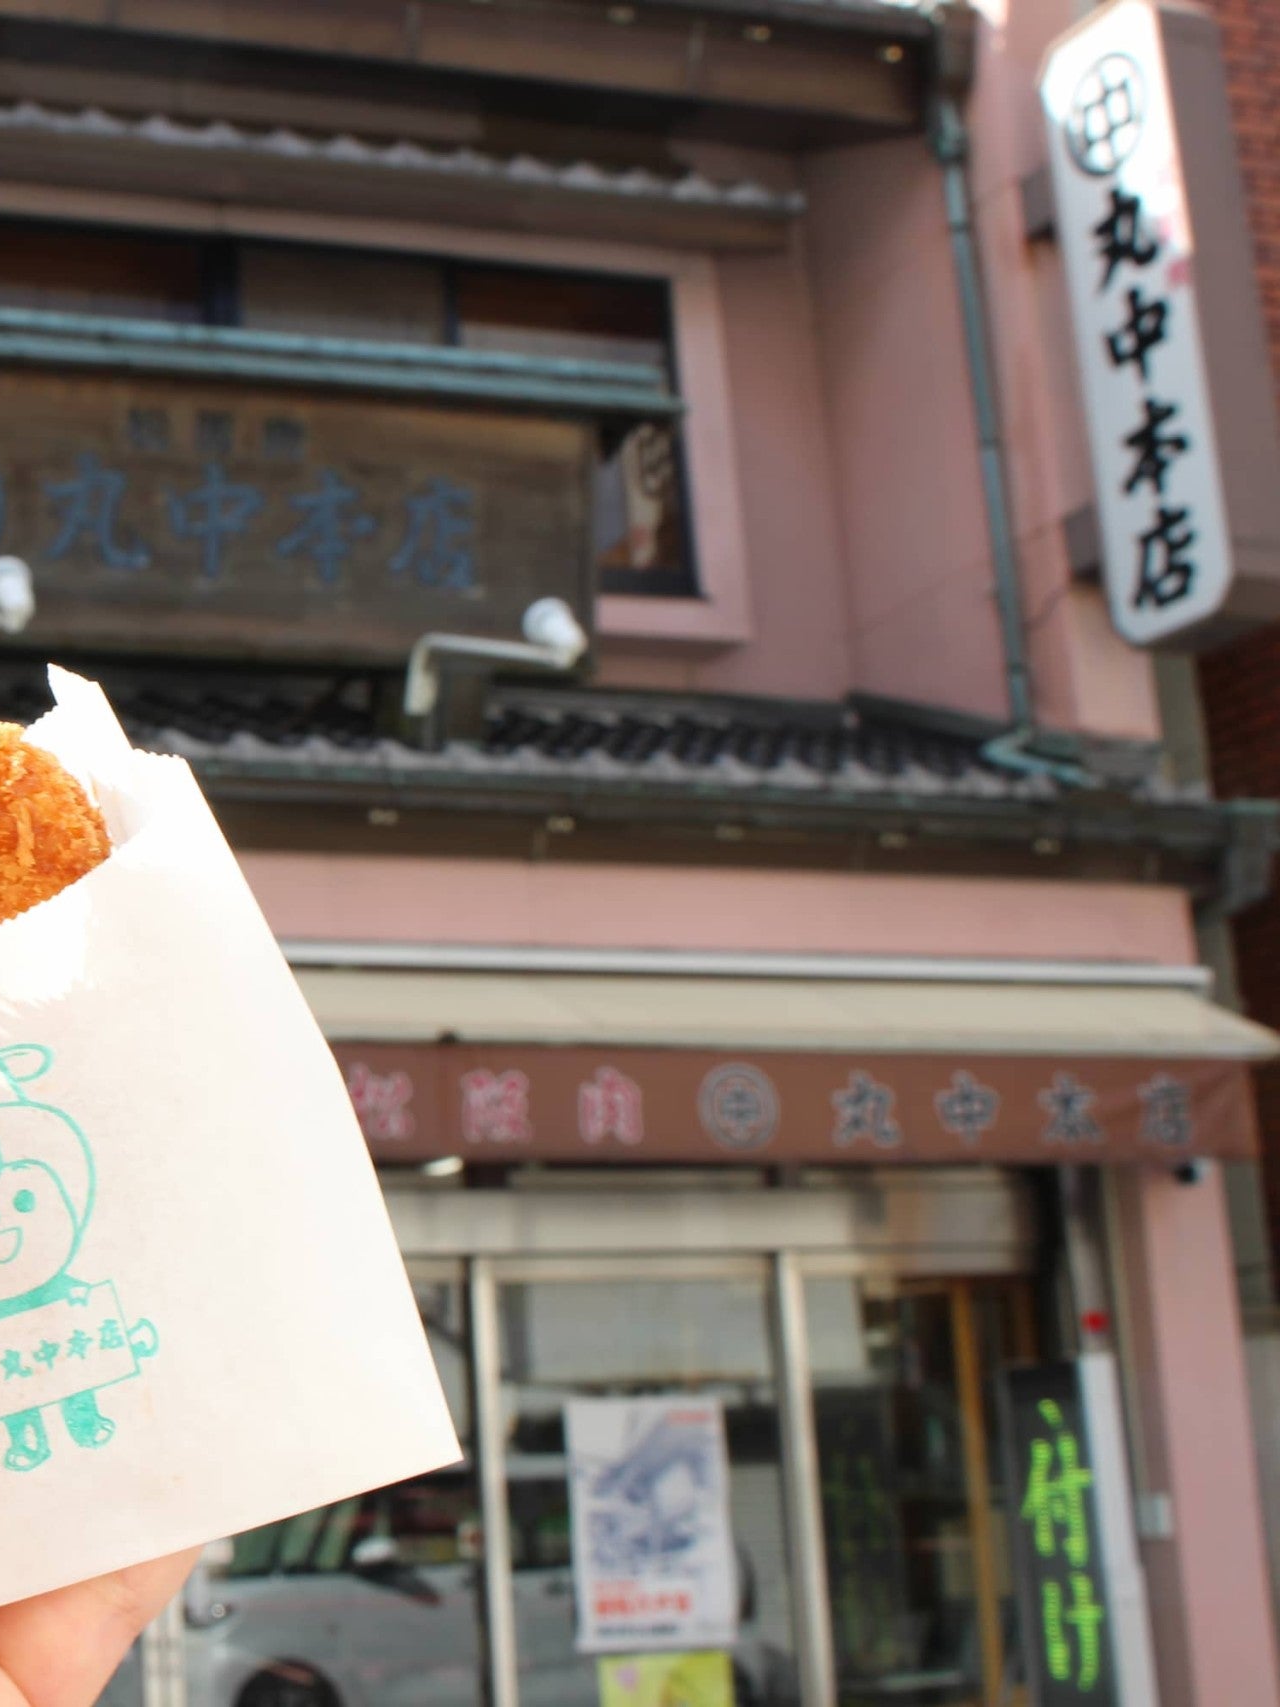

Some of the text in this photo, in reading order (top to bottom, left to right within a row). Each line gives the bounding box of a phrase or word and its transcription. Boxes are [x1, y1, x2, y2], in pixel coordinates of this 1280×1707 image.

[1093, 188, 1195, 610] 丸中本店
[42, 452, 477, 592] 丸中本店
[830, 1068, 1196, 1150] 丸中本店
[1021, 1398, 1103, 1693] 付け
